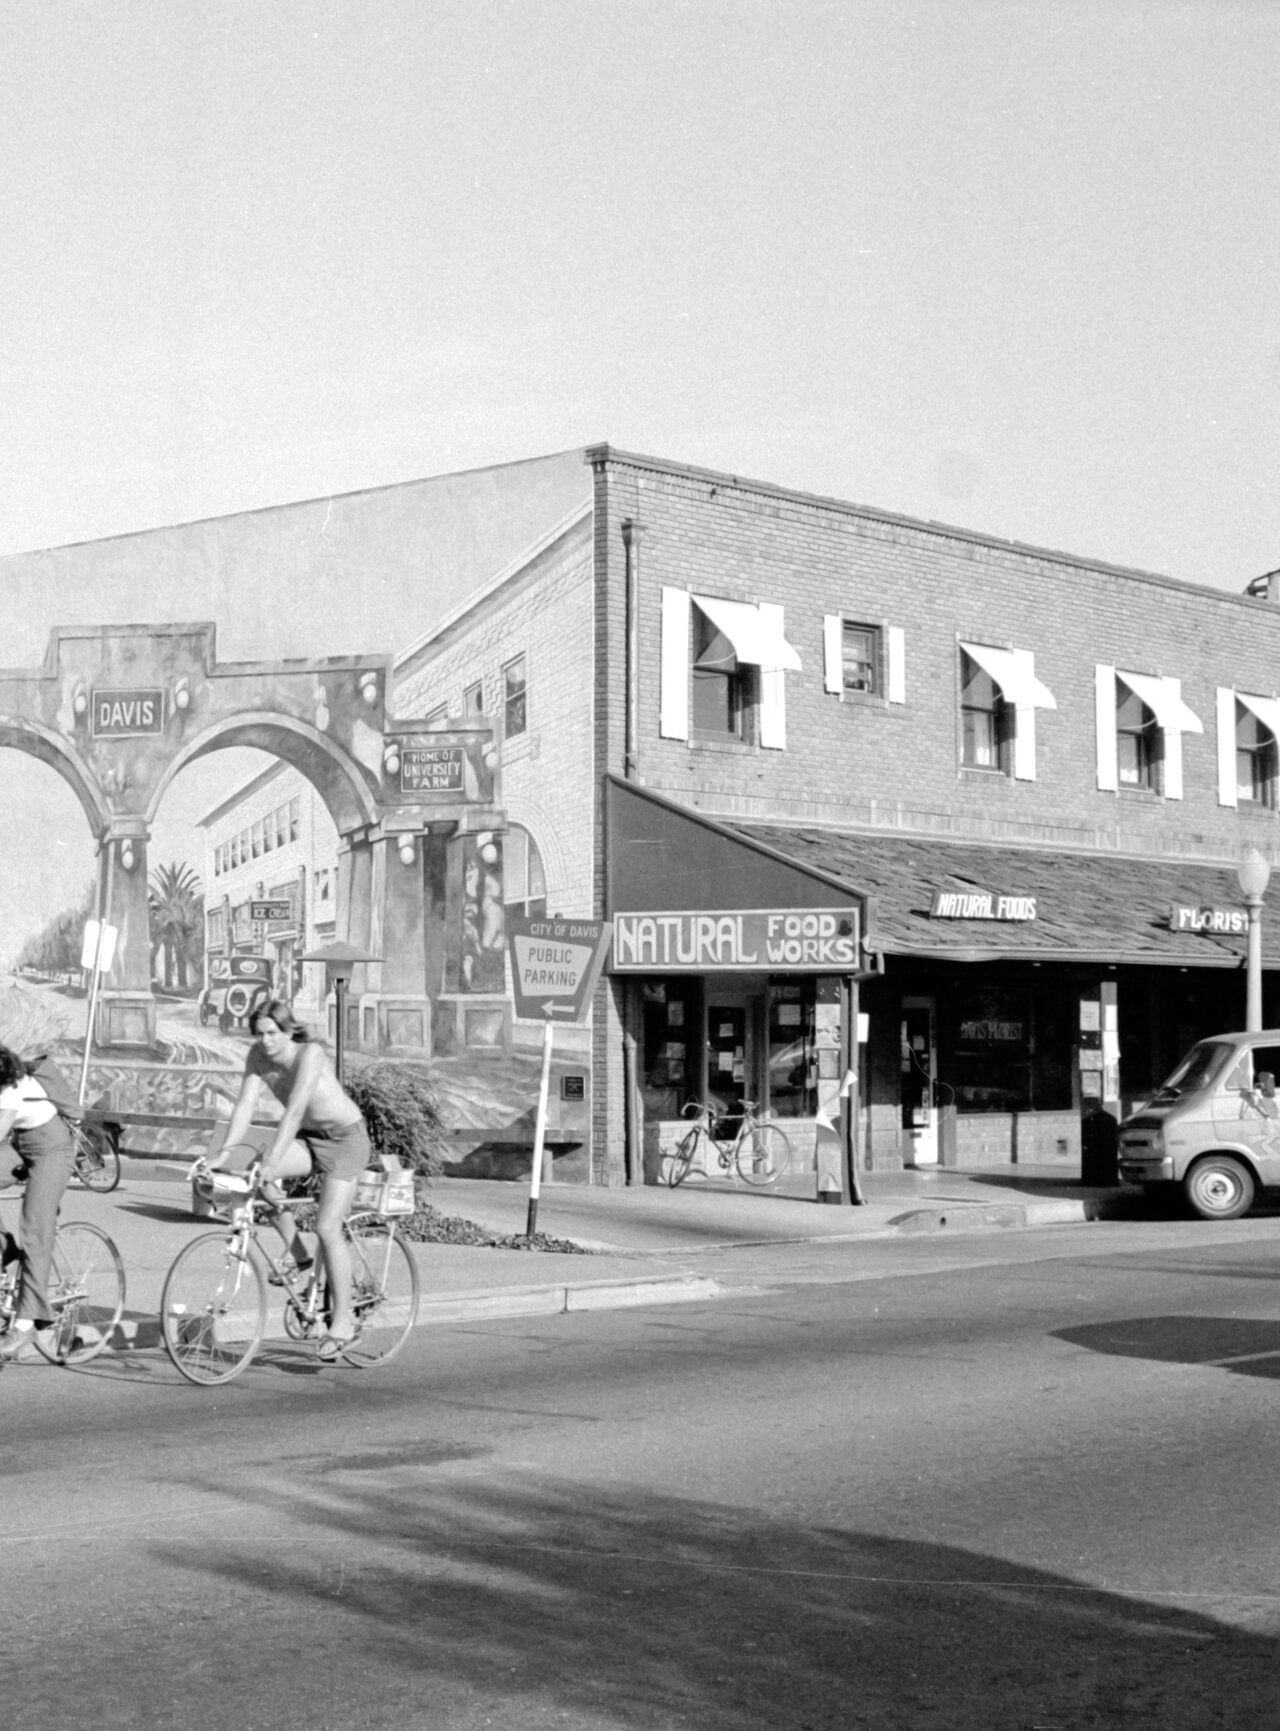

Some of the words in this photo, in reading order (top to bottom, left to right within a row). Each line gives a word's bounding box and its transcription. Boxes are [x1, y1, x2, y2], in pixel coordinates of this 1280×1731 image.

[101, 701, 153, 726] DAVIS
[412, 752, 439, 763] HOME
[442, 749, 456, 760] OF
[404, 762, 460, 777] UNIVERSITY
[413, 777, 449, 788] FARM
[936, 893, 995, 918] NATURAL
[997, 896, 1037, 920] FOODS
[1179, 908, 1249, 931] FLORIST
[530, 923, 552, 936] CITY
[554, 925, 567, 936] OF
[570, 926, 599, 938] DAVIS
[619, 916, 757, 963] NATURAL
[768, 915, 837, 937] FOOD
[528, 947, 573, 964] PUBLIC
[766, 939, 854, 963] WORKS
[524, 968, 577, 986] PARKING
